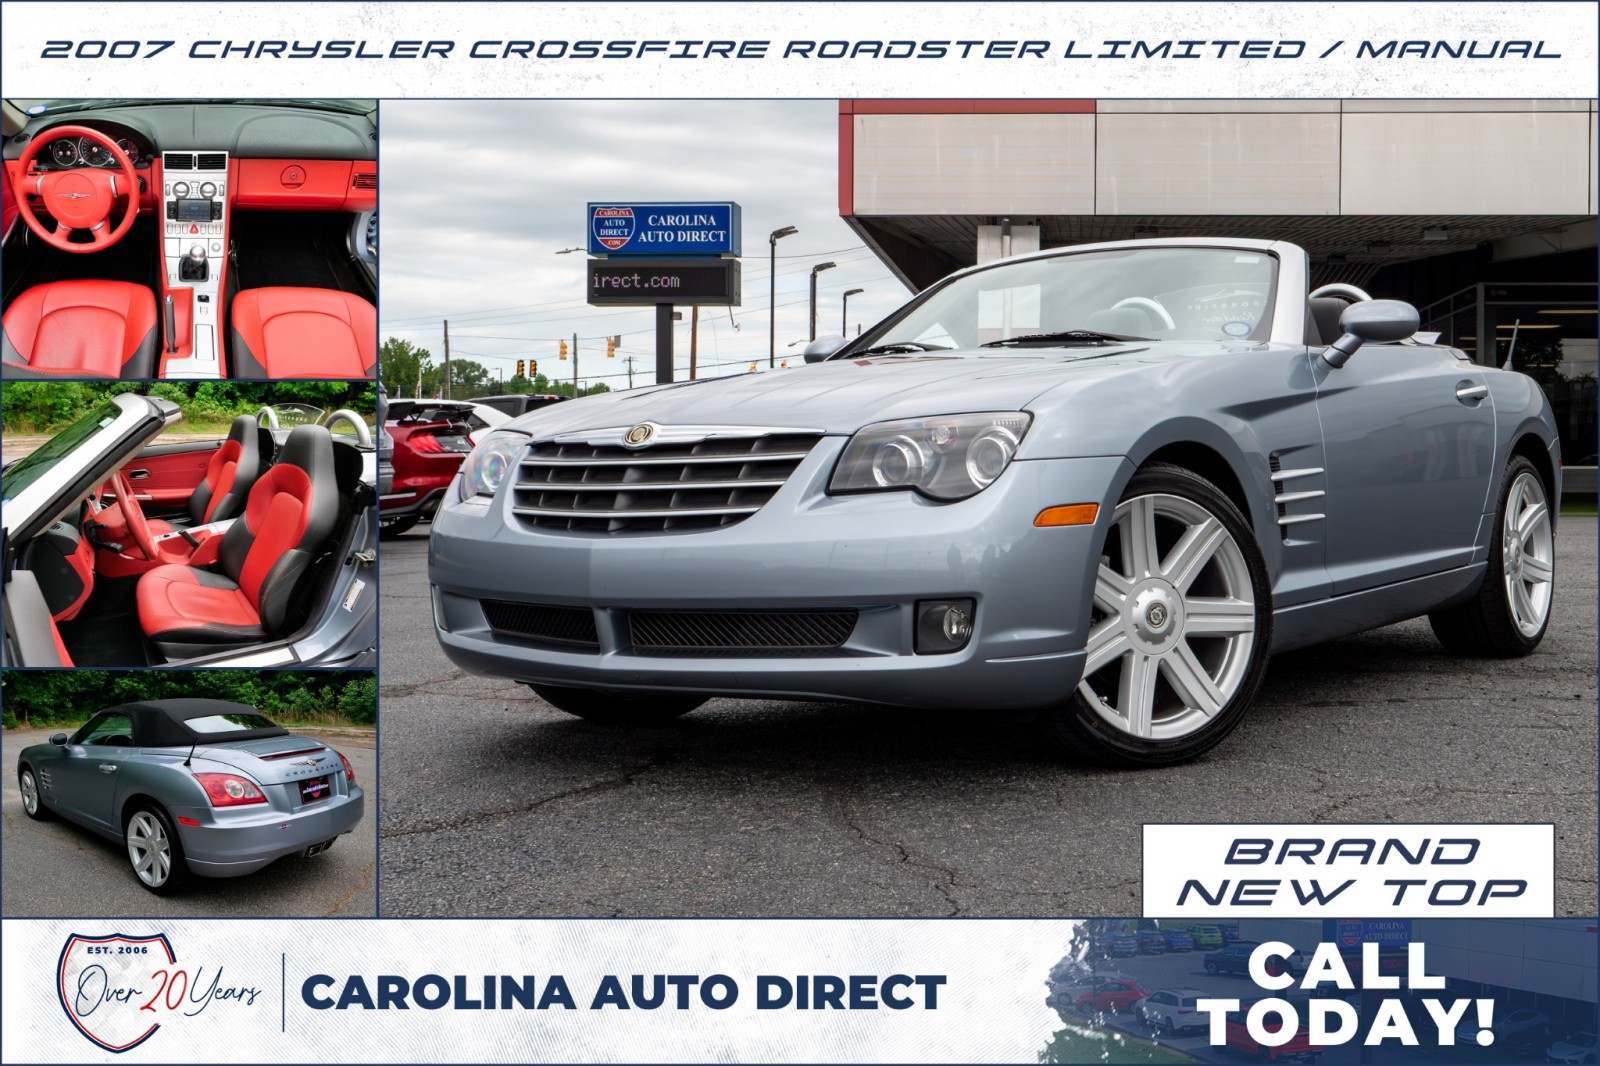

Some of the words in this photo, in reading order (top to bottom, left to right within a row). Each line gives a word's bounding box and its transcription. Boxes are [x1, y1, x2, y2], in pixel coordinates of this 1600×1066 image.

[603, 219, 626, 227] AUTO
[648, 215, 717, 226] CAROLINA
[600, 228, 629, 236] DIRECT
[638, 231, 674, 243] AUTO
[677, 230, 726, 242] DIRECT
[593, 273, 681, 289] irect.com
[1364, 933, 1383, 941] AUTO
